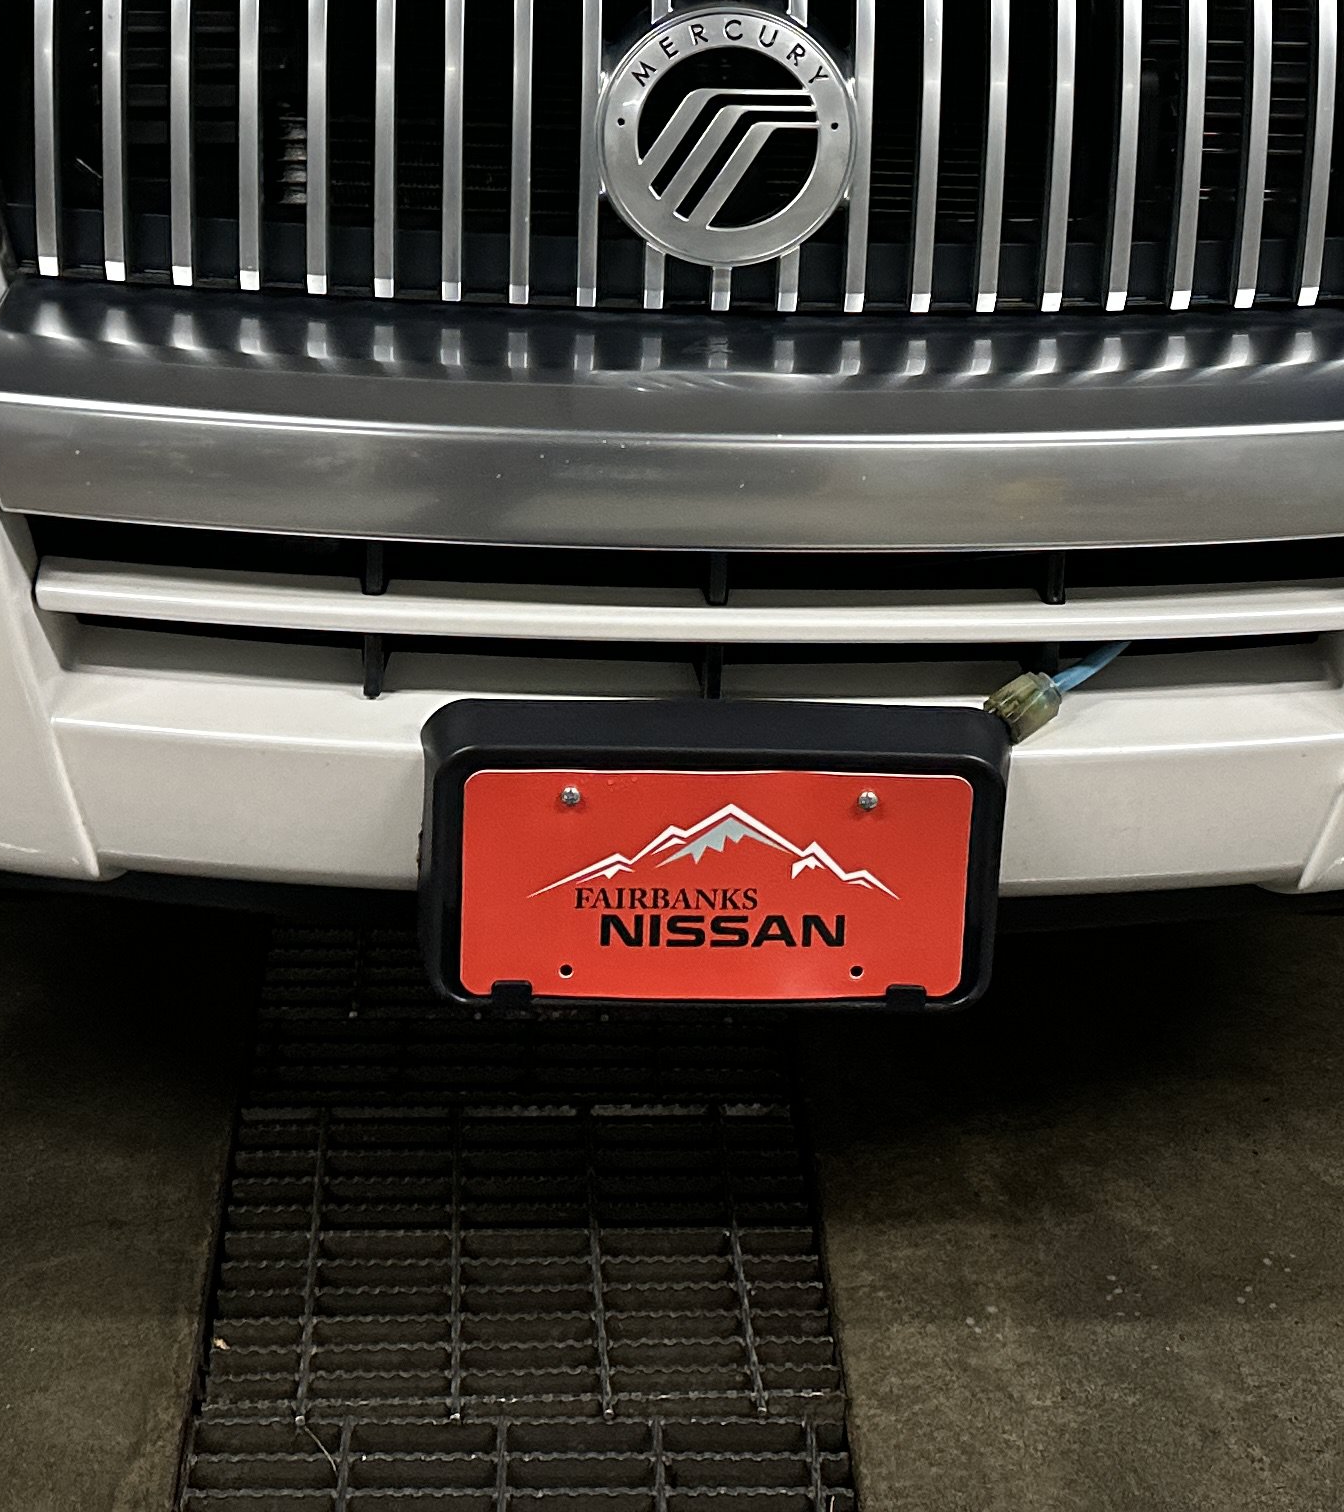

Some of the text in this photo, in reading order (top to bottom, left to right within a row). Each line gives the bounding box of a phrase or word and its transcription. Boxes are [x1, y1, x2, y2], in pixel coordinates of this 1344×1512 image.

[631, 20, 830, 88] MERCURY
[574, 888, 759, 911] FAIRBANKS
[599, 914, 847, 948] NISSAN
